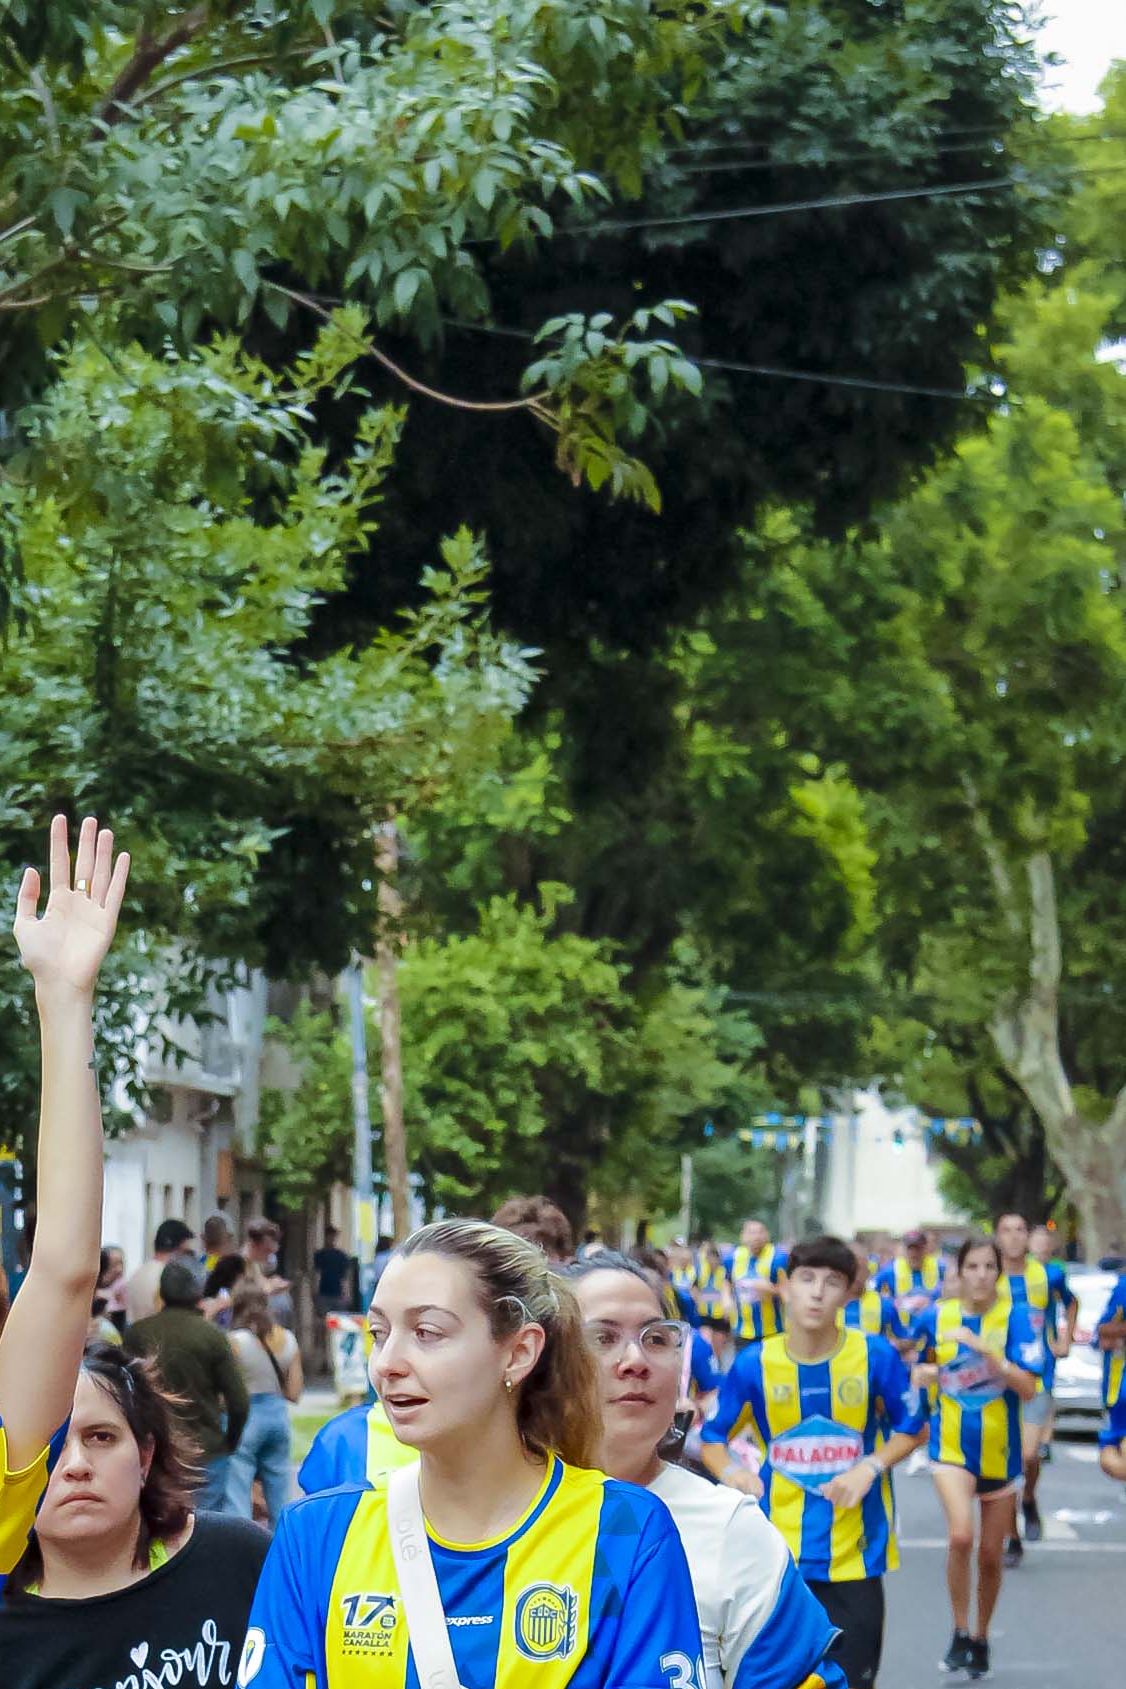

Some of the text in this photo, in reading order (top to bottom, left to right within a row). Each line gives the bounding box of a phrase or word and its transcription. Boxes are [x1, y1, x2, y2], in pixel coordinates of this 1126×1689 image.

[343, 1595, 396, 1627] 17
[343, 1630, 392, 1640] MARATÓN
[343, 1638, 390, 1648] CANALLA
